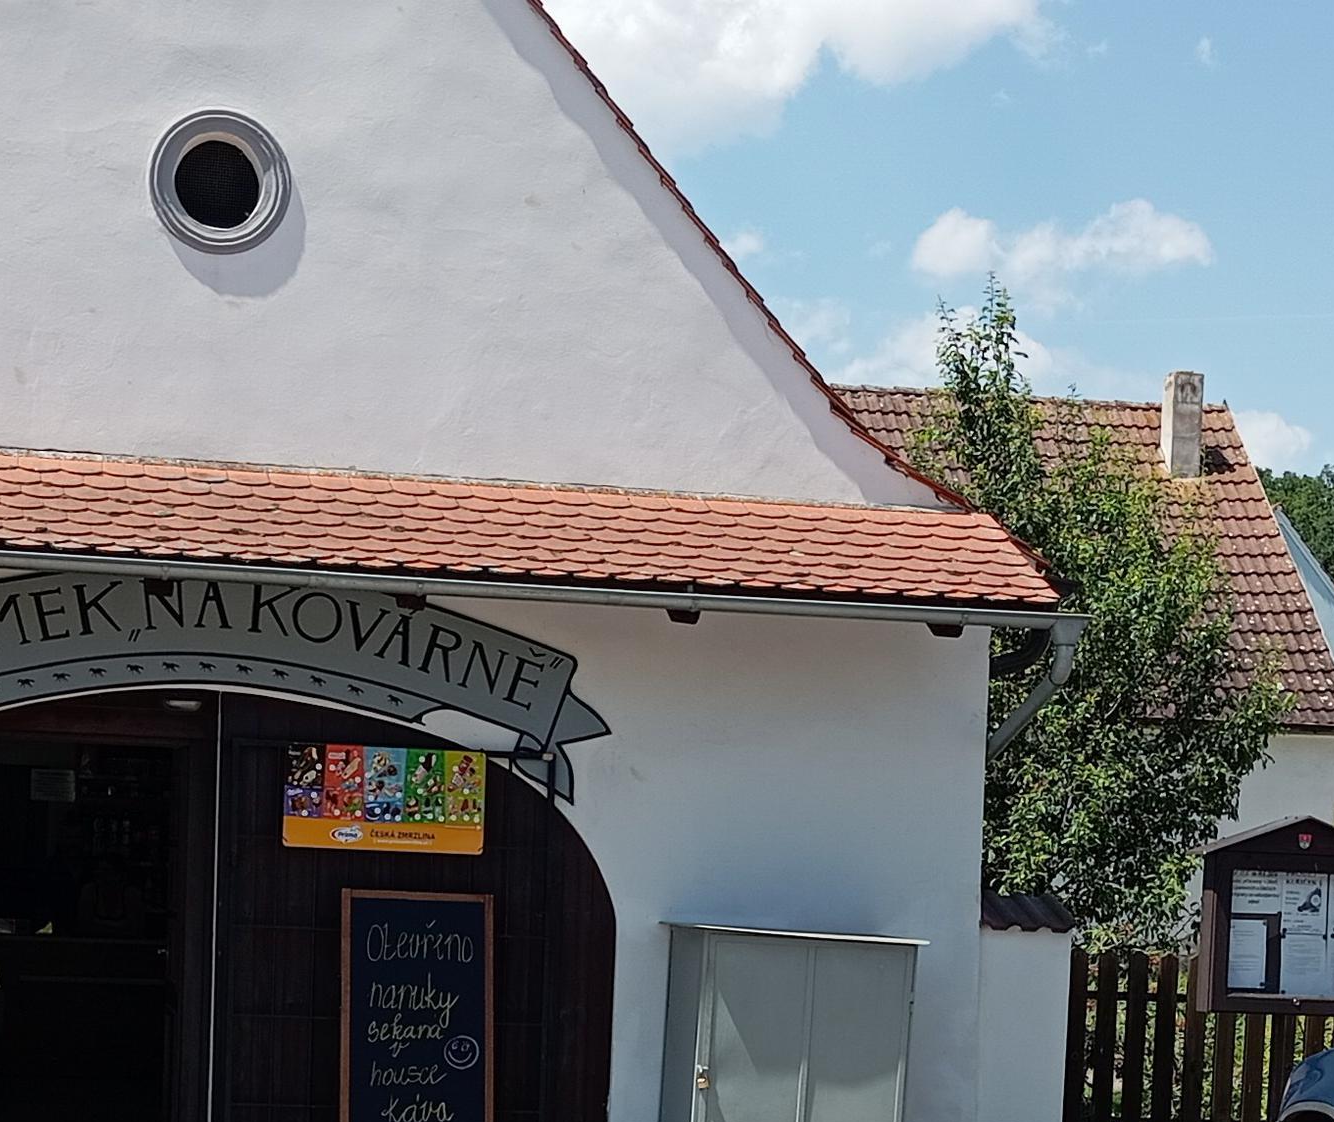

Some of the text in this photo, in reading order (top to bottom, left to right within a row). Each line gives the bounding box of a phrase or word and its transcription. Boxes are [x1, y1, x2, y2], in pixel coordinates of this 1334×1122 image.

[366, 919, 474, 963] Otevřeno
[369, 972, 460, 1029] nanuky
[388, 1041, 410, 1057] v
[370, 1060, 448, 1087] housce
